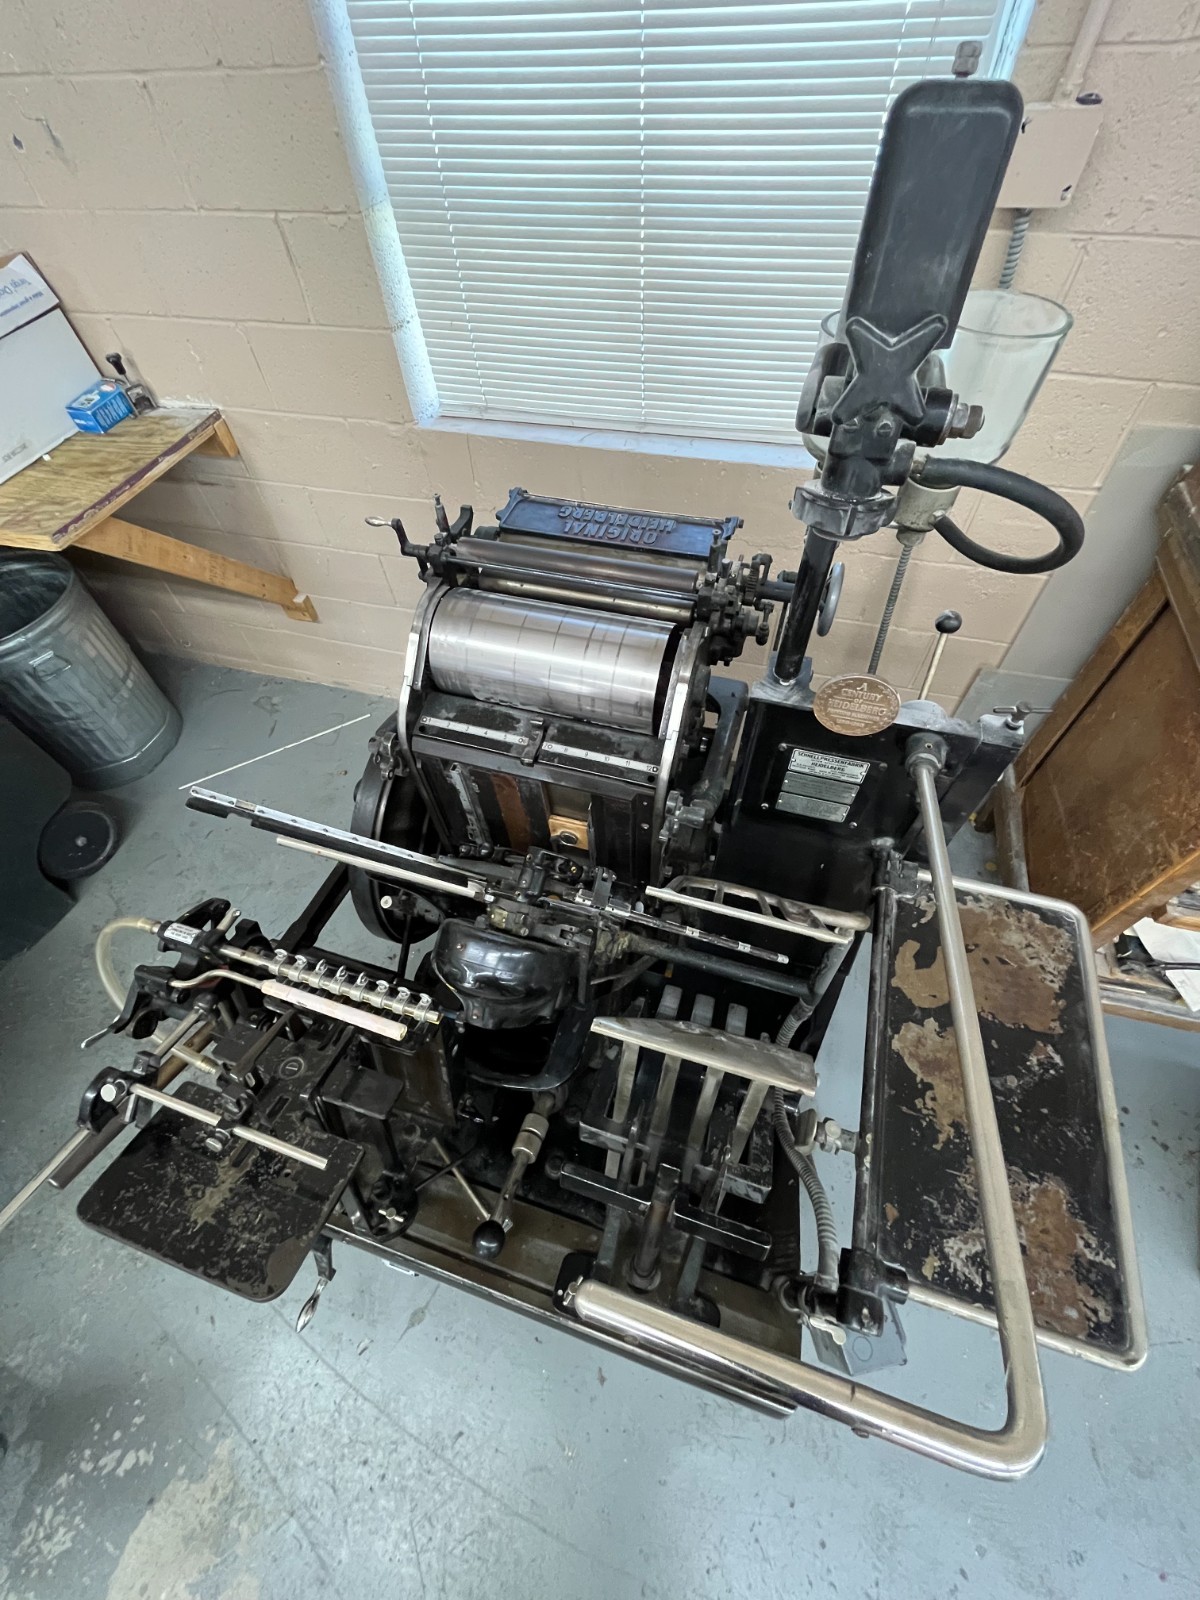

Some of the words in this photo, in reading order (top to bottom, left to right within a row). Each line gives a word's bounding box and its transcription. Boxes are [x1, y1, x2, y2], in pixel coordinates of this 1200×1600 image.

[558, 505, 677, 534] HEIDELBERG
[564, 519, 659, 545] ORIGINAL
[841, 688, 884, 702] CENTURY
[828, 698, 888, 716] HEIDELBERG
[811, 762, 846, 771] HEIDELBERG
